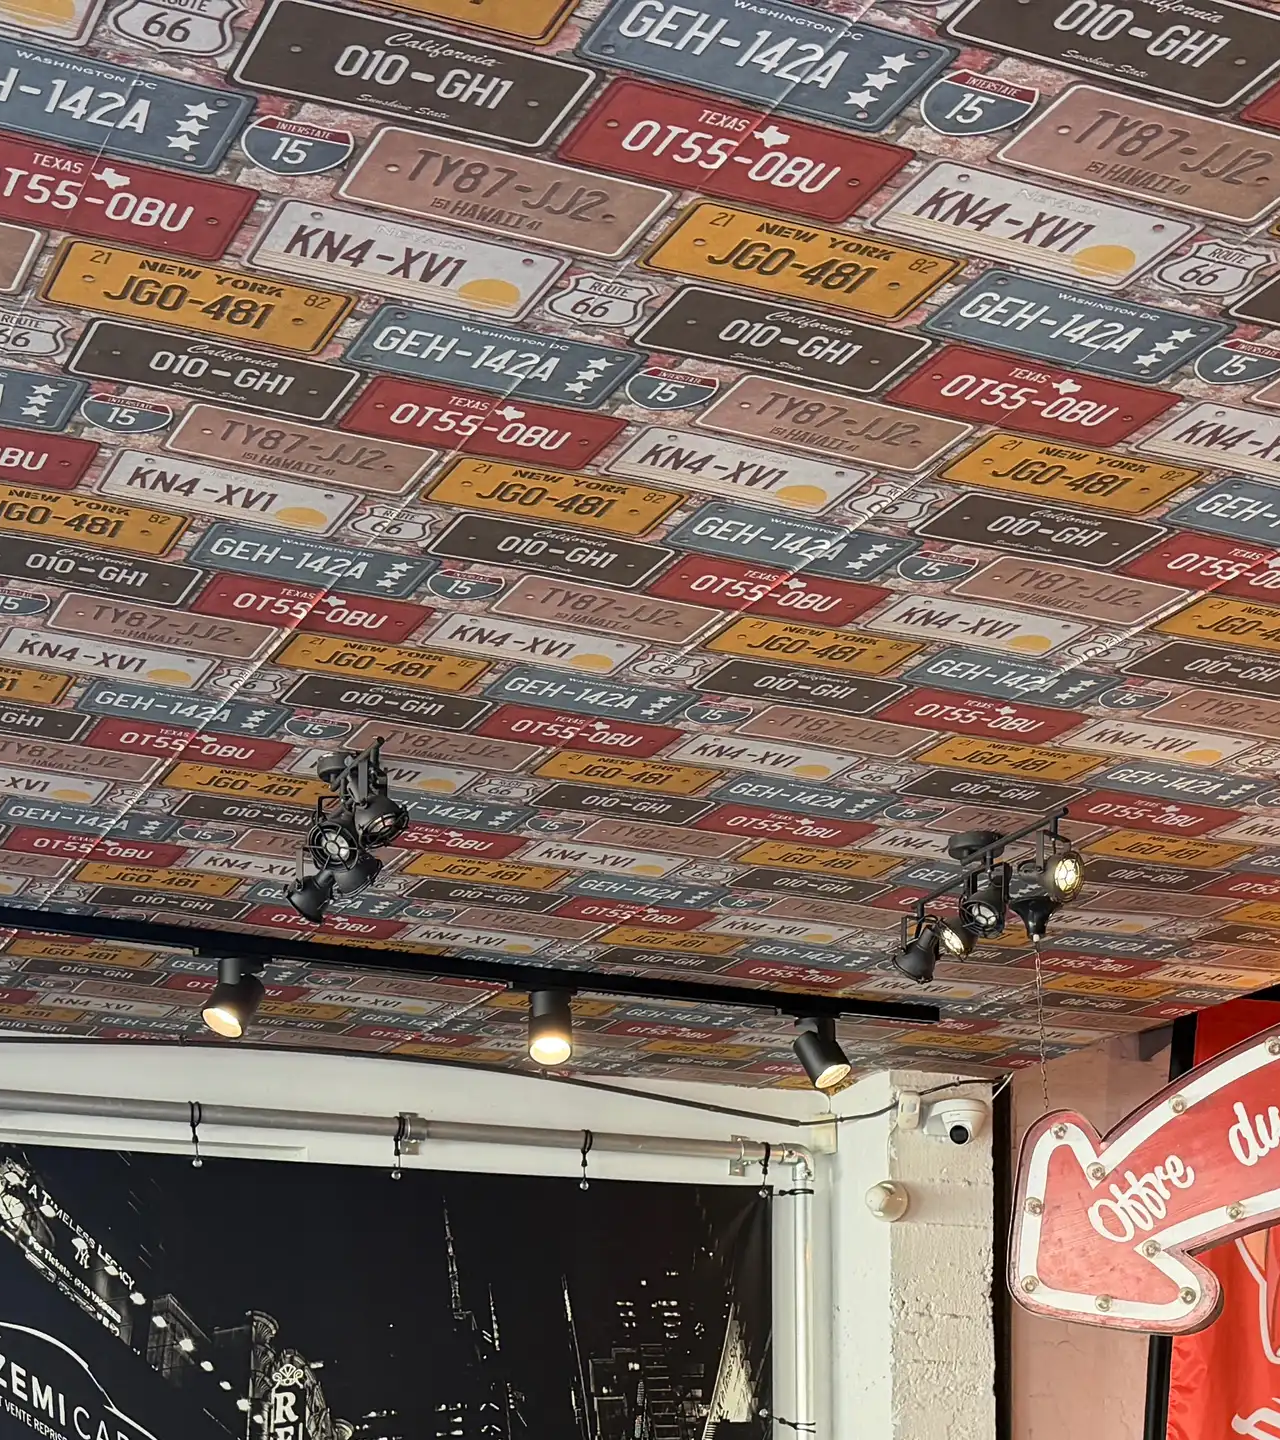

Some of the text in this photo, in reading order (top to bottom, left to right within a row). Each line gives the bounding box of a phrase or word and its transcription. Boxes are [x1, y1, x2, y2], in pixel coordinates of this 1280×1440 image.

[385, 32, 504, 68] California
[15, 49, 157, 90] WASHINGTON DC
[963, 75, 1017, 98] INTERSTATE
[696, 109, 749, 134] TEXAS
[945, 92, 983, 124] 15
[276, 120, 333, 141] INTERSTATE
[32, 152, 85, 174] TEXAS
[271, 138, 307, 165] 15
[1070, 109, 1270, 186] TY87-JJ2
[405, 148, 612, 223] TY87-JJ2
[913, 187, 1097, 253] KN4-XV1
[89, 250, 111, 264] 21
[283, 224, 468, 288] KN4-XV1
[755, 221, 895, 263] NEW YORK
[1206, 246, 1251, 266] ROUTE
[138, 259, 331, 310] NEW YORK 82
[1184, 265, 1224, 287] 66
[1, 314, 46, 328] ROUTE
[960, 293, 1146, 355] GEH-142A
[372, 327, 562, 383] GEH-142A
[504, 677, 637, 710] GEH-142A
[1087, 1154, 1194, 1243] Offre
[4, 1399, 32, 1427] VENTE
